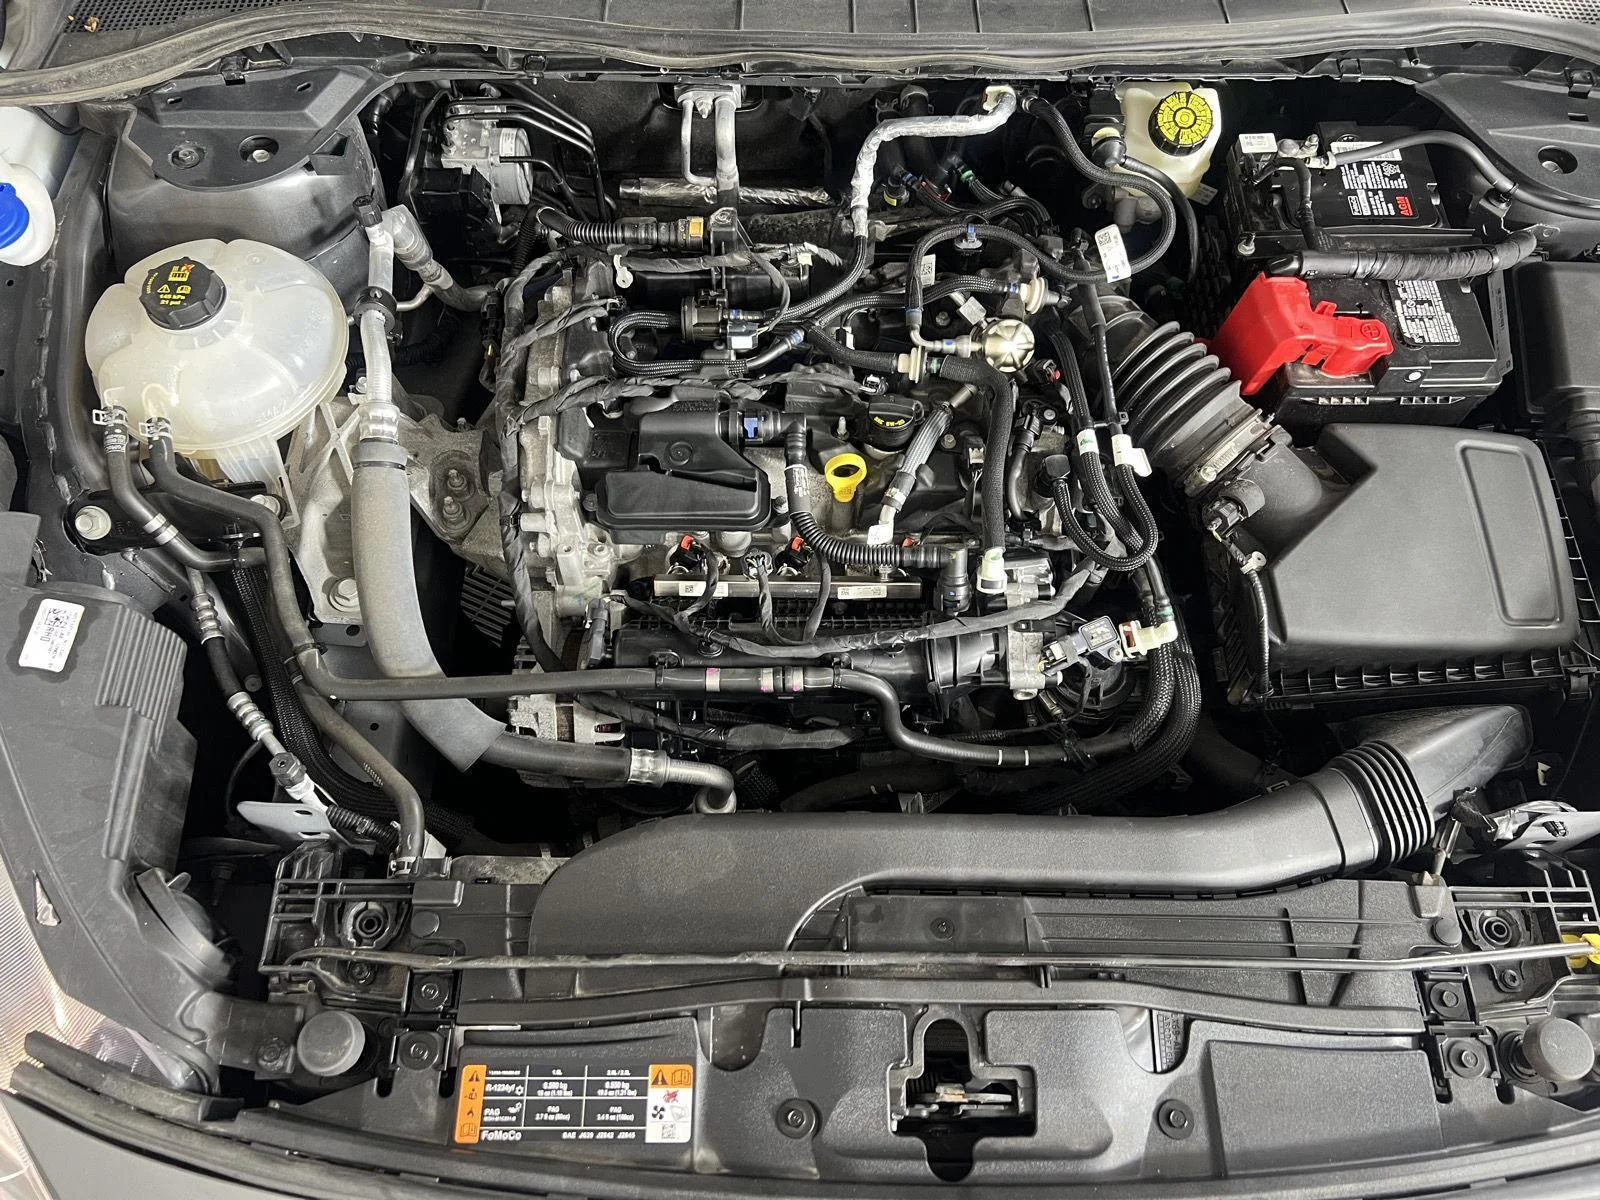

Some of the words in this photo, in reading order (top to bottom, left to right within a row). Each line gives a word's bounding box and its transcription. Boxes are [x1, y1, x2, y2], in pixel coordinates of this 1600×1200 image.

[1396, 196, 1409, 216] AGM
[484, 1108, 501, 1116] PAG
[481, 1130, 522, 1141] FoMoCo
